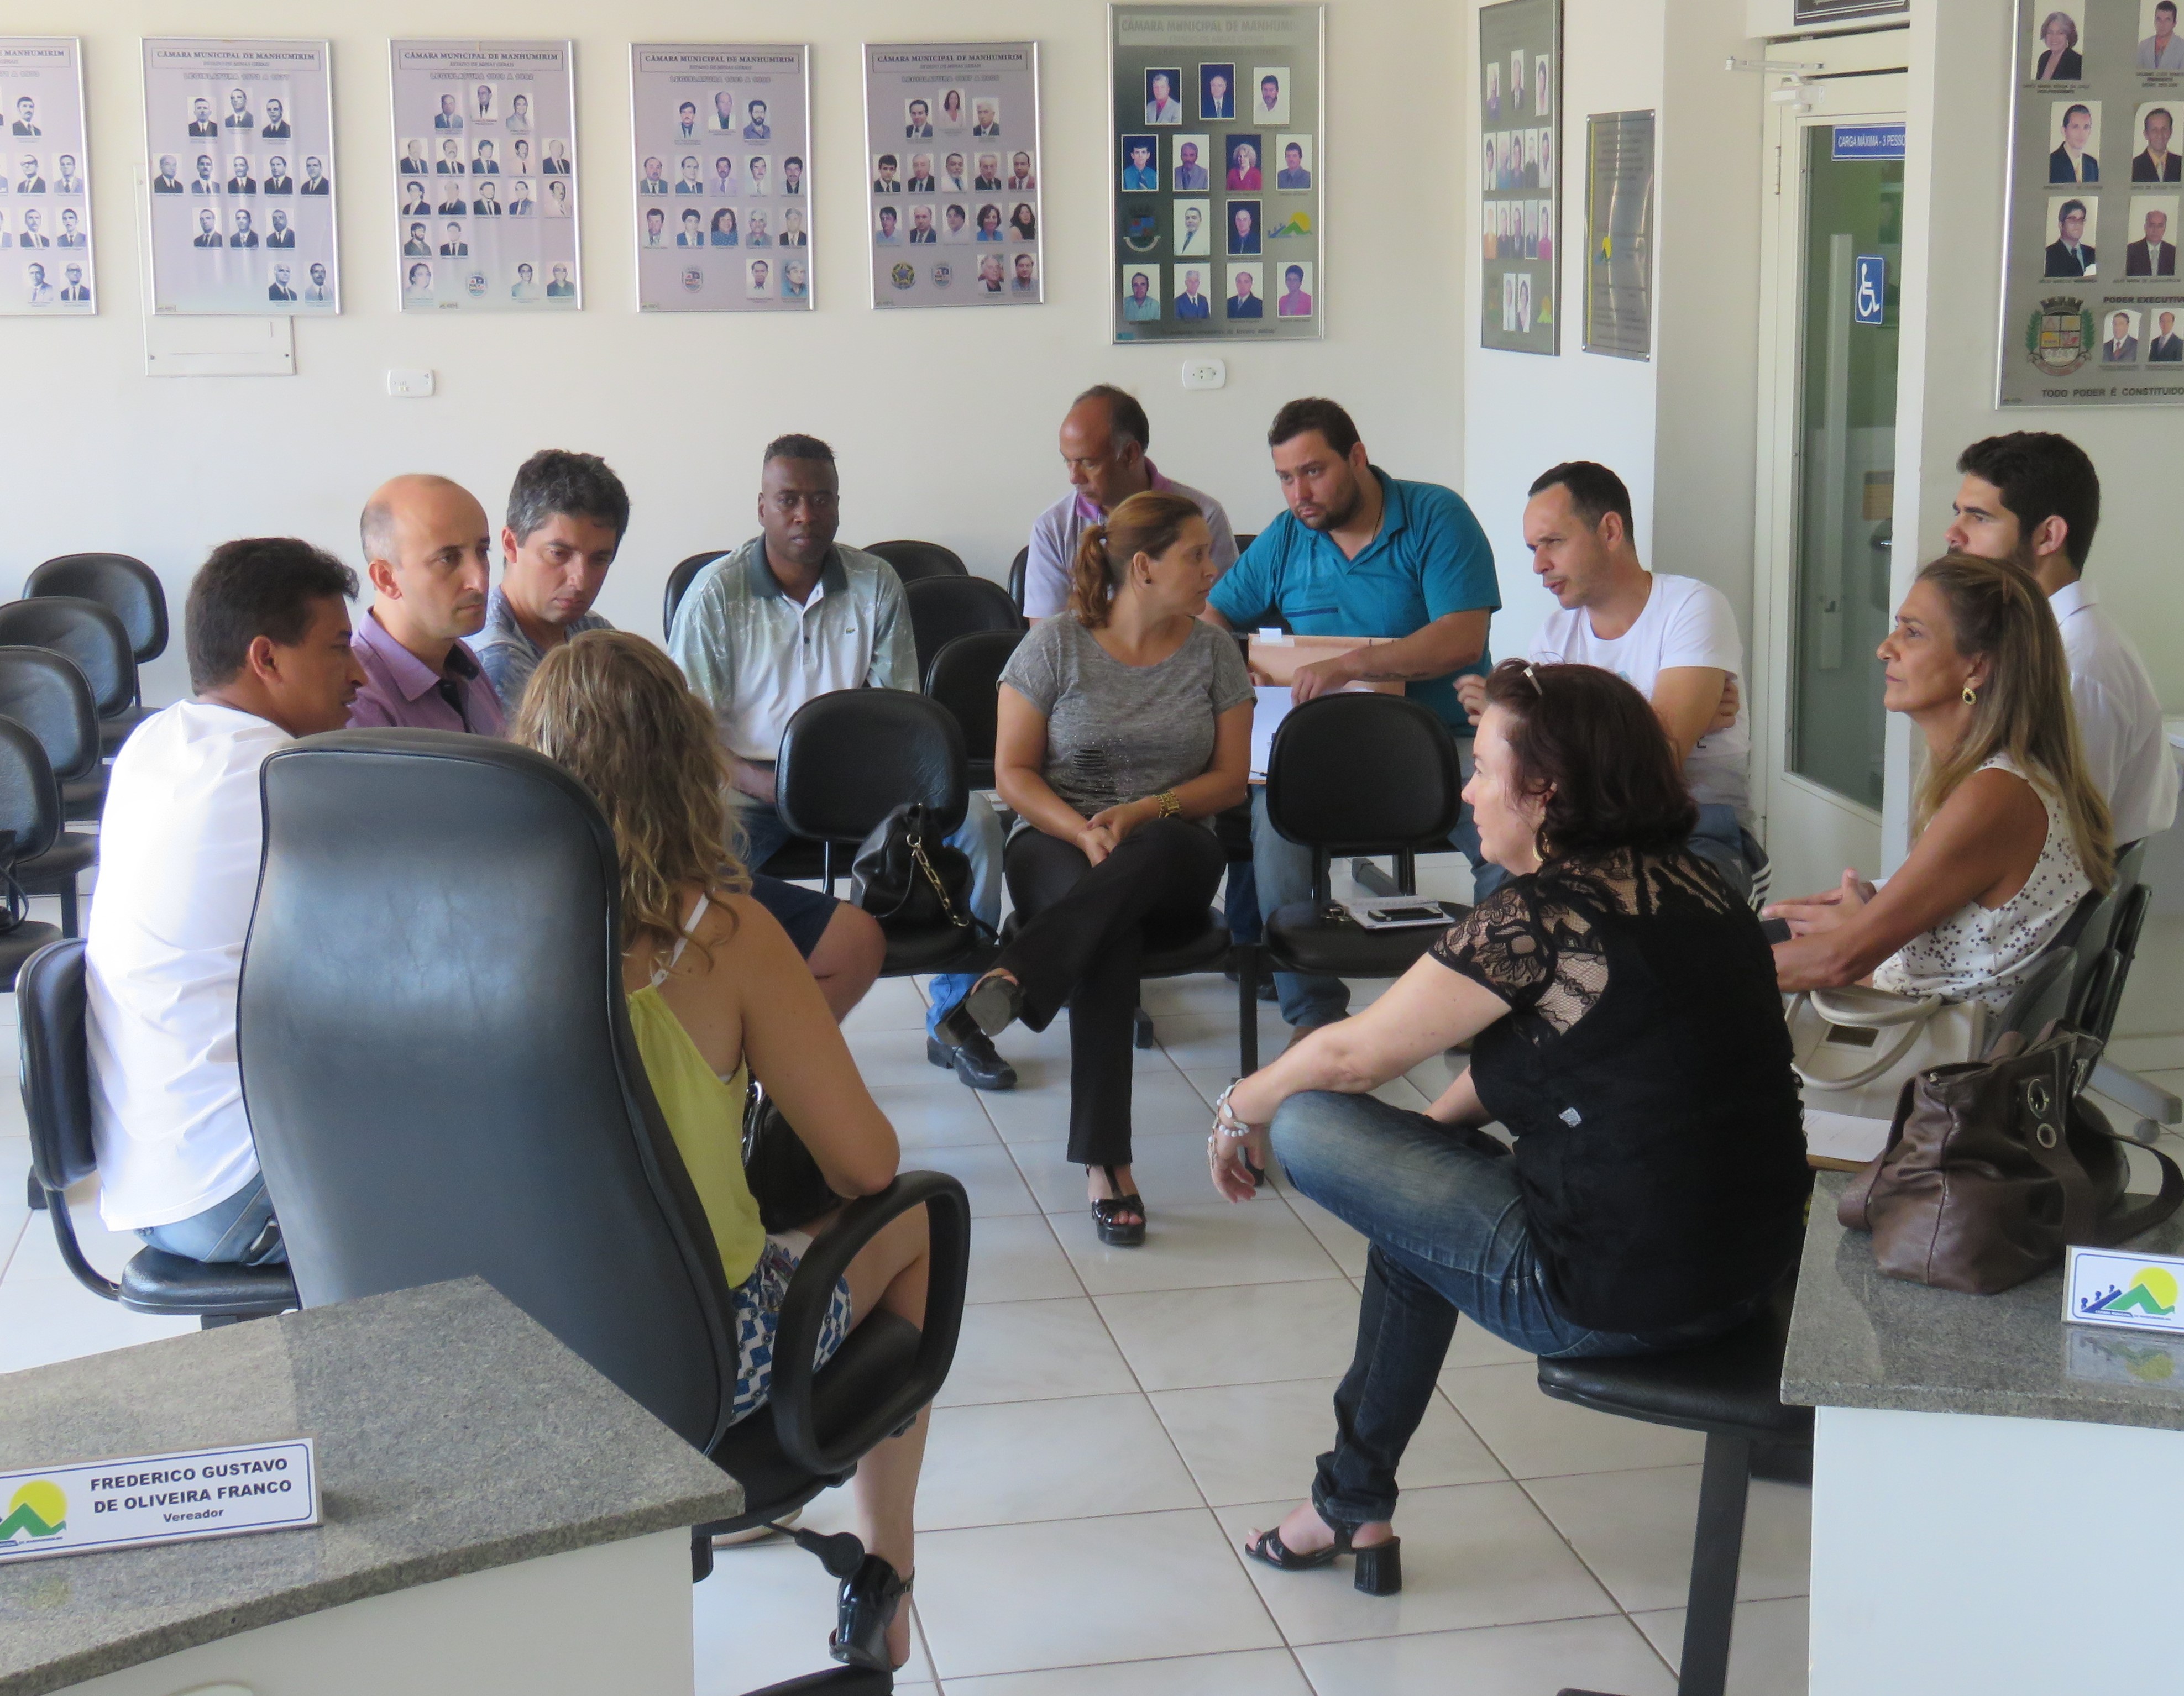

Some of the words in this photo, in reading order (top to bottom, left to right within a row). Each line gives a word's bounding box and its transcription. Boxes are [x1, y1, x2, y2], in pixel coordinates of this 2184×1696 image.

[1838, 135, 1857, 148] CARGA
[1857, 133, 1878, 146] MÁXIMA
[1882, 135, 1886, 147] 3
[2042, 389, 2068, 397] TODO
[2073, 389, 2105, 397] PODER
[2110, 387, 2117, 396] É
[90, 1467, 196, 1492] FREDERICO
[202, 1458, 288, 1479] GUSTAVO
[94, 1499, 118, 1514] DE
[124, 1489, 210, 1509] OLIVEIRA
[217, 1479, 292, 1500] FRANCO
[163, 1508, 224, 1523] Vereador
